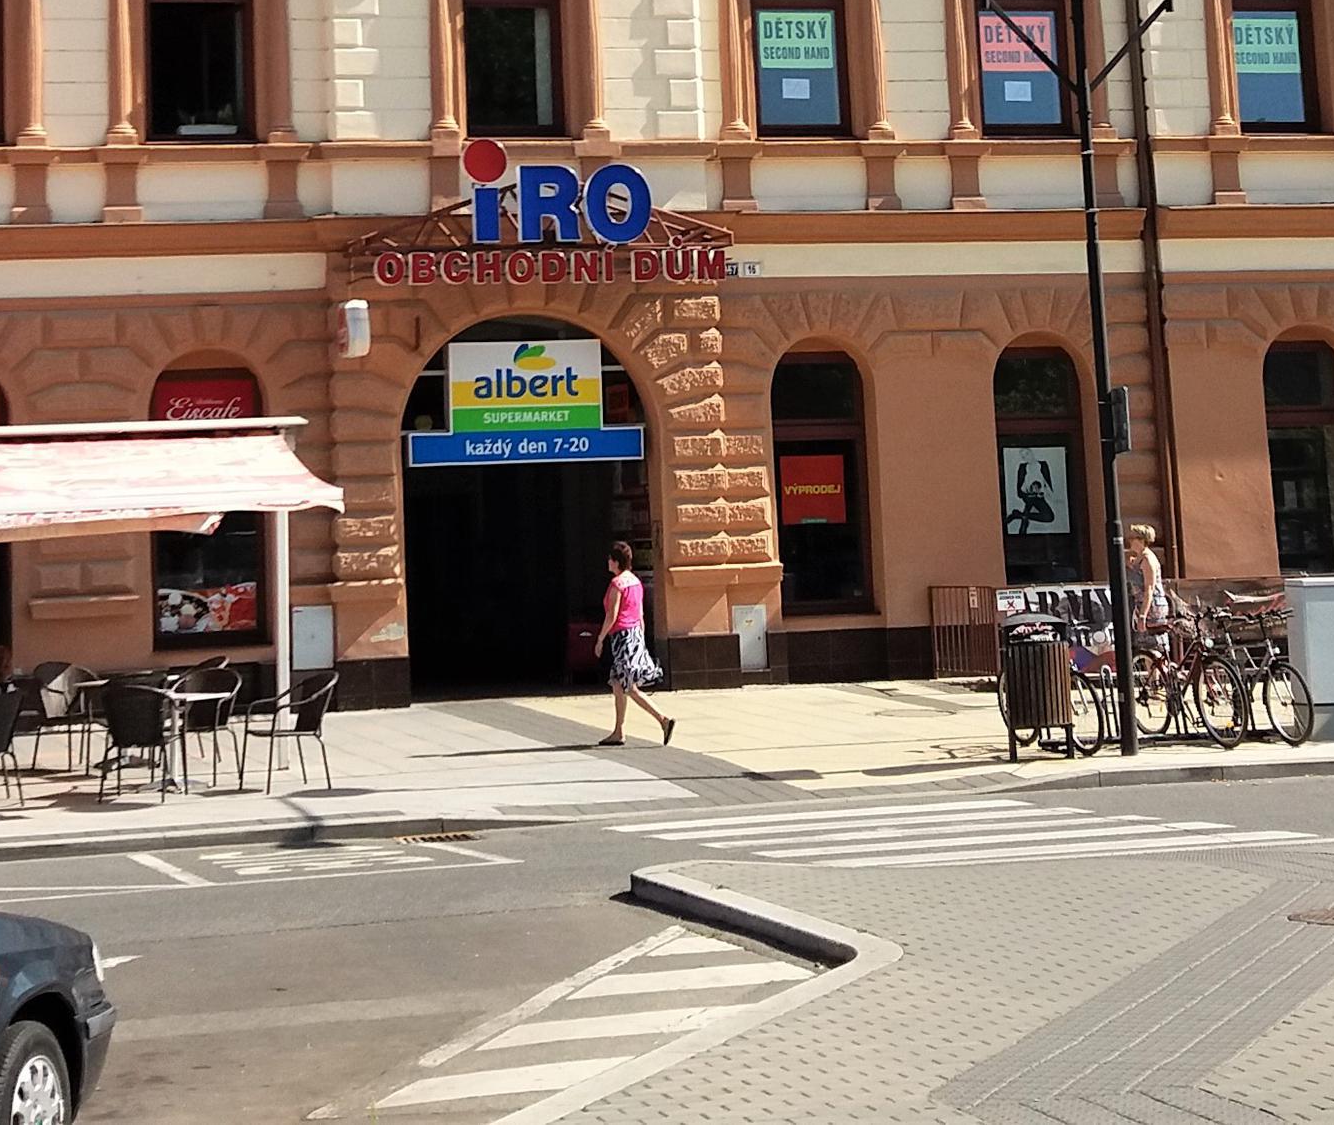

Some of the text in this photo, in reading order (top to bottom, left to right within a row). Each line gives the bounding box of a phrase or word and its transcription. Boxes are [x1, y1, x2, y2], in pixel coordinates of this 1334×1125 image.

[763, 16, 828, 40] DĚTSKÝ
[1234, 23, 1294, 45] DĚTSKÝ
[763, 46, 831, 60] SECOND HAND
[983, 50, 1022, 63] SECOND
[1235, 51, 1297, 65] SECOND HAND
[373, 235, 727, 287] OBCHODNÍ DŮM
[473, 367, 579, 400] albert
[482, 409, 570, 425] SUPERMARKET
[465, 436, 590, 457] každý den 7-20
[783, 482, 842, 496] VÝPRODEJ
